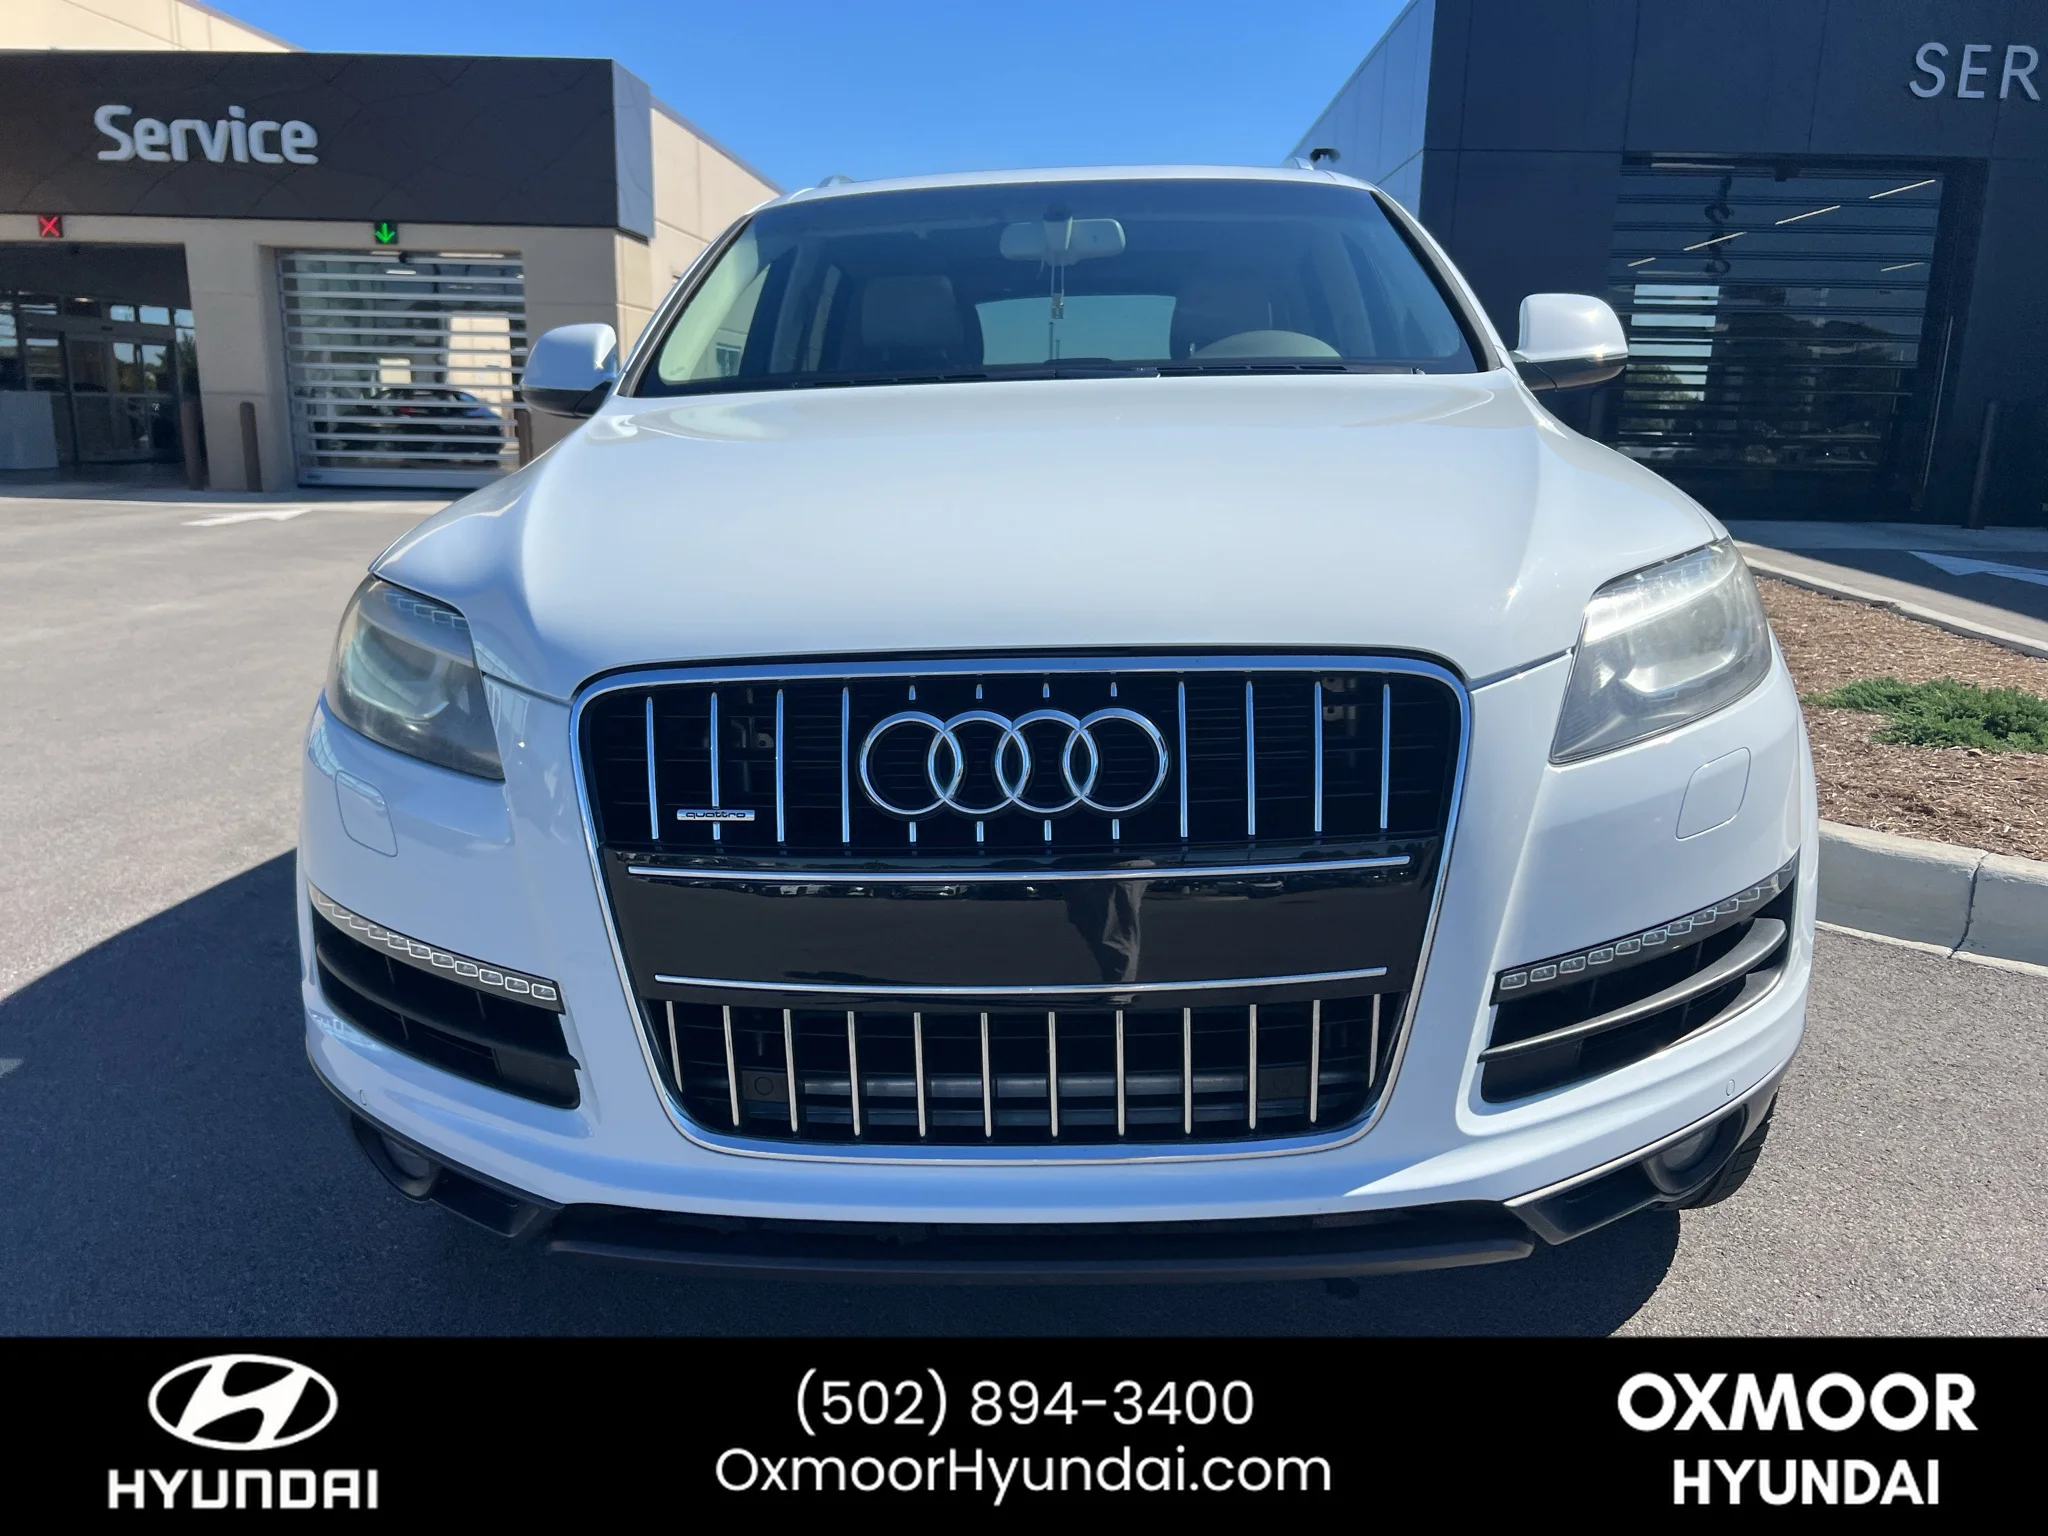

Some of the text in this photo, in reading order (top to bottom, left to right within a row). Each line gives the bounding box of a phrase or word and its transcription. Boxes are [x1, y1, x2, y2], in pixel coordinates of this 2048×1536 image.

[1909, 42, 2041, 100] SER
[95, 104, 319, 164] Service
[685, 811, 746, 819] quattro
